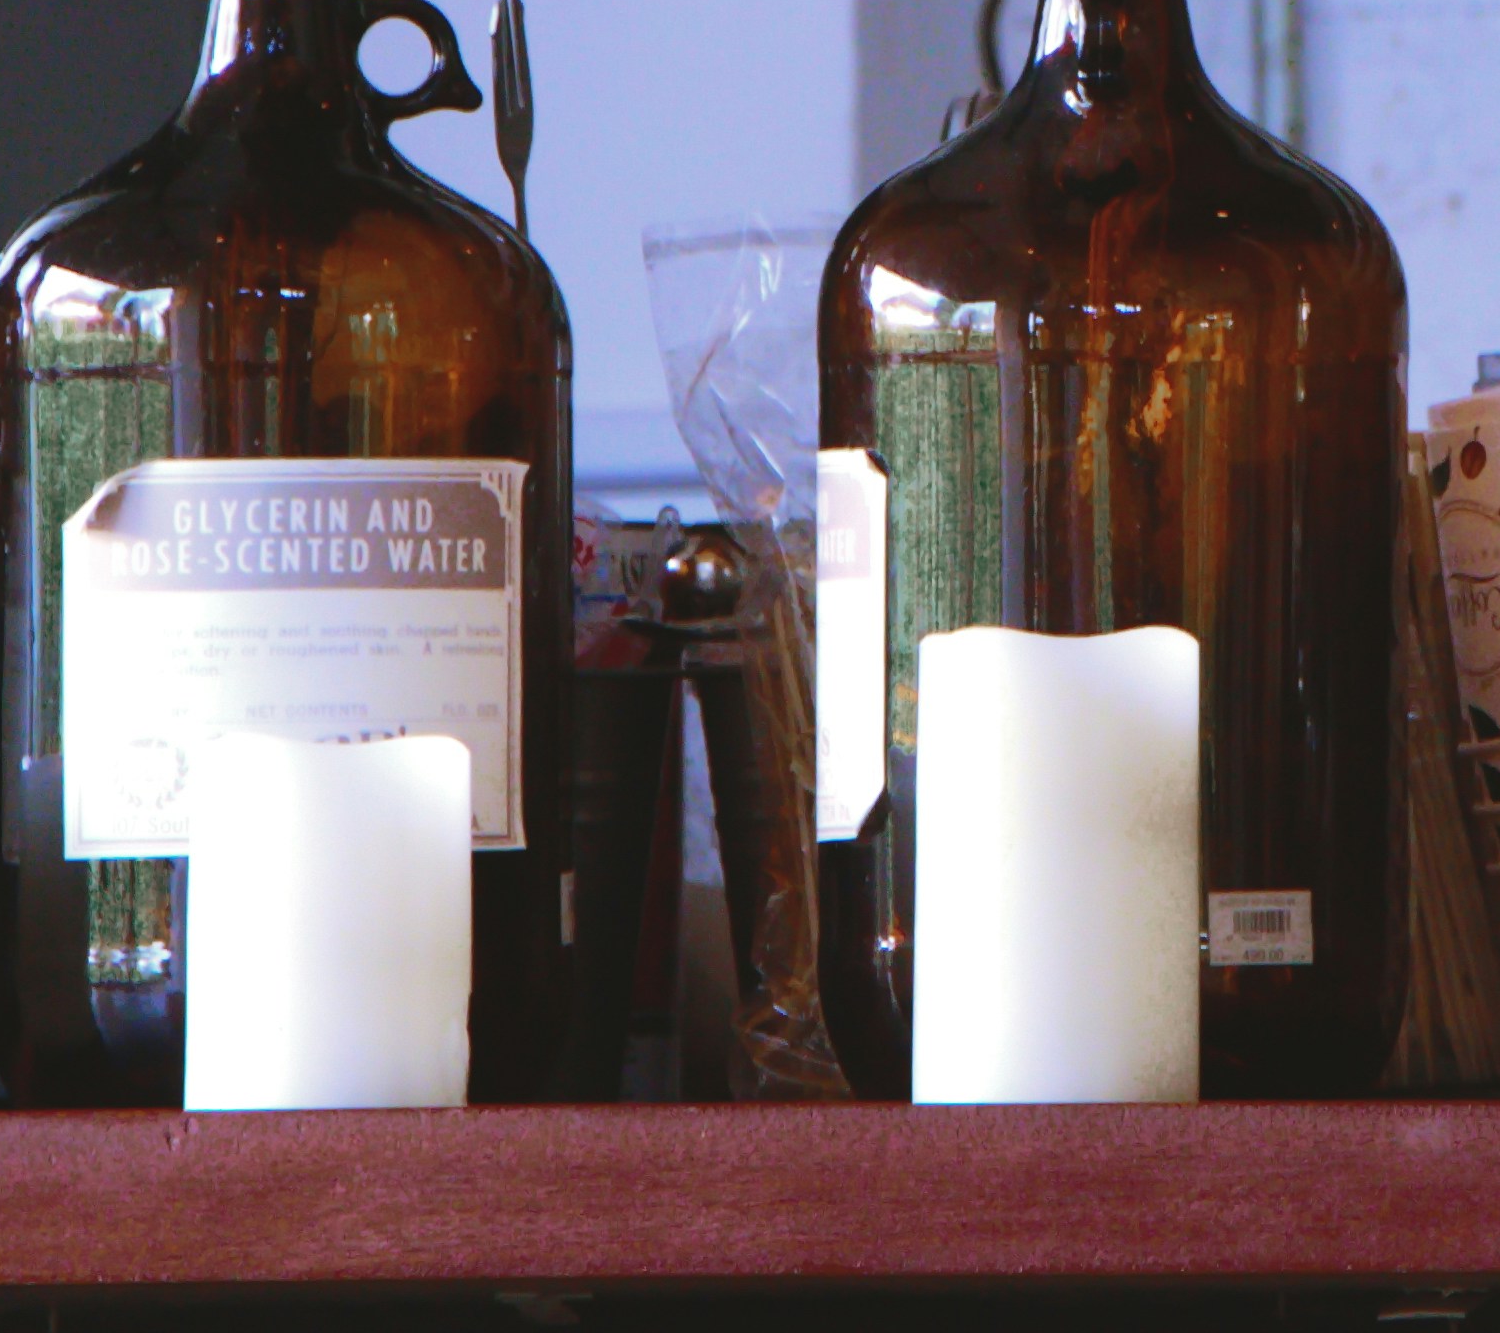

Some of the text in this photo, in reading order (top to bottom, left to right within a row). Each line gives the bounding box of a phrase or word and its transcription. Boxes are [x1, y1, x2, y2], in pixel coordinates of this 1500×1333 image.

[173, 497, 434, 534] GLYCERIN AND
[109, 538, 487, 577] ROSE-SCENTED WATER
